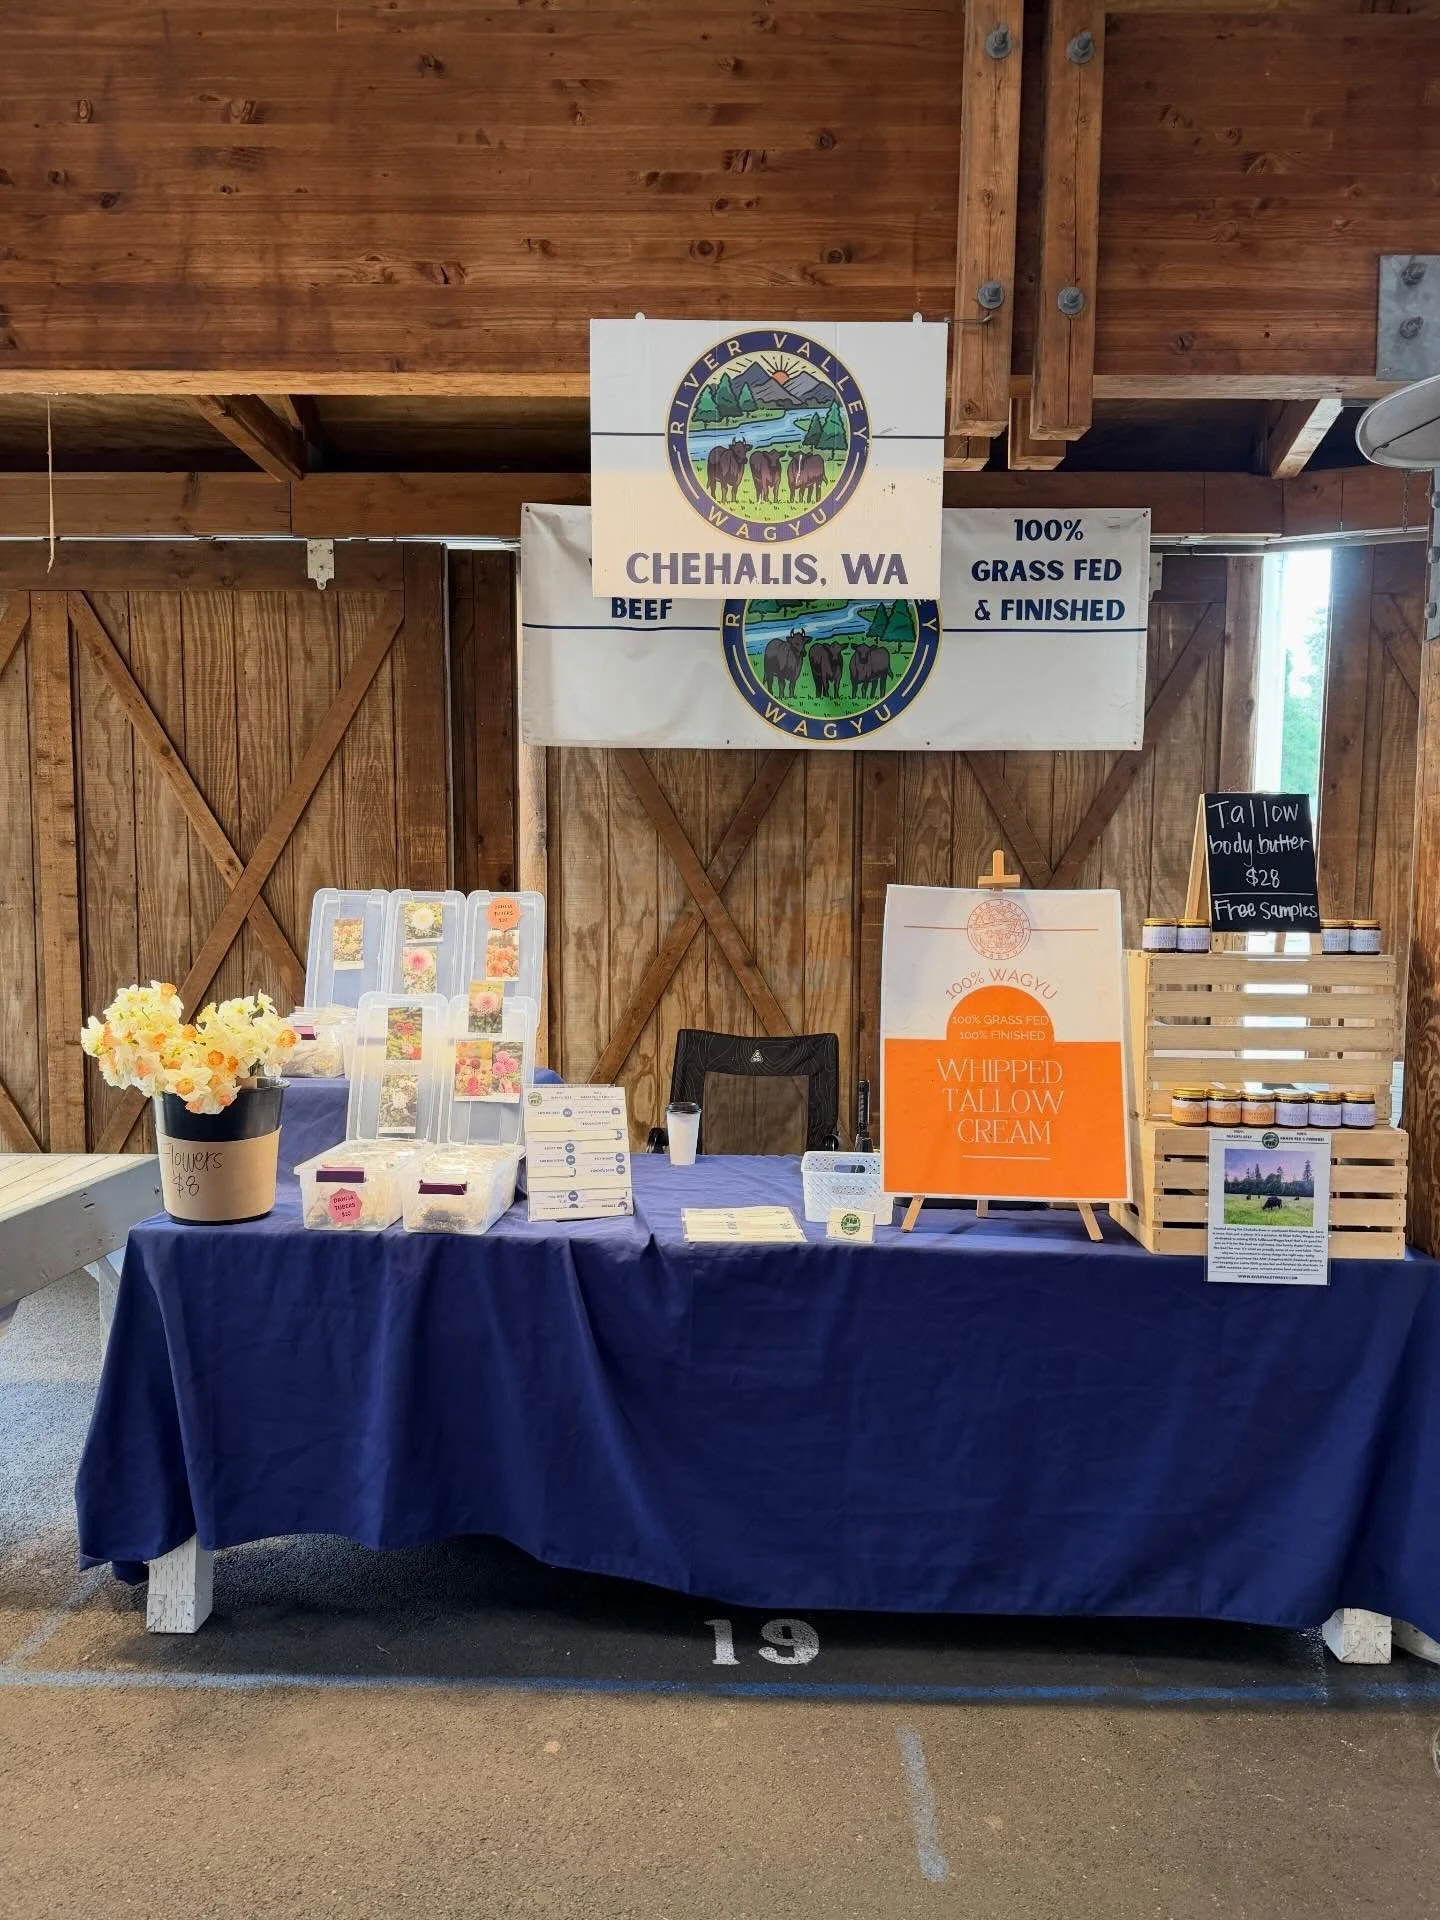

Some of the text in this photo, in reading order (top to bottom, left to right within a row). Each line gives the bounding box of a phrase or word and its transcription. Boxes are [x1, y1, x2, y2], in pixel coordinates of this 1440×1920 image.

[670, 333, 868, 440] RIVER VALLEY
[707, 506, 828, 542] WAGYU
[1014, 519, 1084, 541] 100%
[626, 552, 909, 587] CHEHALIS, WA
[972, 558, 1122, 582] GRASS FED
[611, 597, 673, 621] BEEF
[974, 599, 1126, 621] & FINISHED
[764, 701, 891, 738] WAGYU
[1208, 799, 1299, 828] Tallow
[1208, 831, 1310, 867] body butter
[1245, 866, 1280, 888] $28
[1214, 899, 1257, 921] Free
[946, 967, 1058, 1000] 100% WAGYU
[952, 1014, 1049, 1026] 100% GRASS FED
[960, 1030, 1046, 1041] 100% FINISHED
[936, 1058, 1063, 1084] WHIPPED
[942, 1087, 1065, 1115] TALLOW
[957, 1118, 1051, 1145] CREAM
[172, 1172, 200, 1199] $8
[704, 1619, 820, 1665] 19
